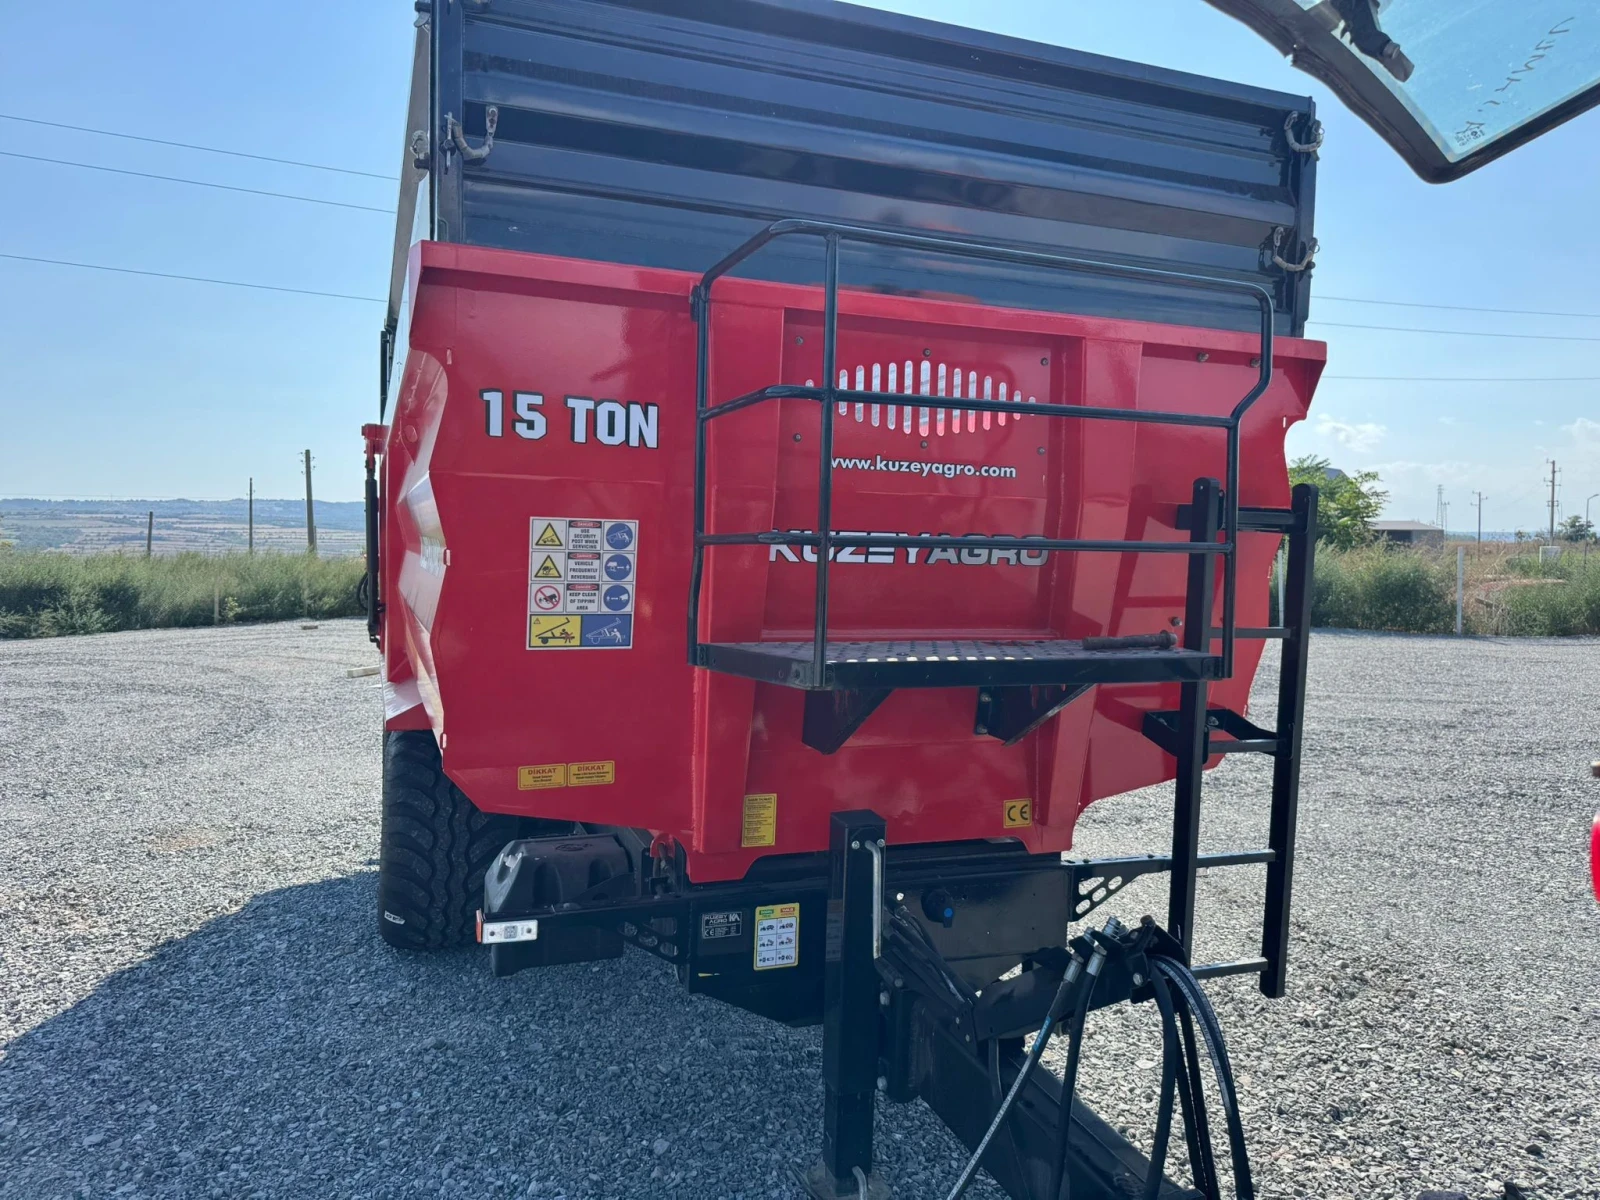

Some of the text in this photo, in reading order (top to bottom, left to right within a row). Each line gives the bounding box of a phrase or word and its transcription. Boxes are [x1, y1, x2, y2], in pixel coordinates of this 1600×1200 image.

[479, 388, 659, 449] 15 TON
[831, 454, 1016, 478] www.kuzeyagro.com
[1007, 804, 1028, 822] CE
